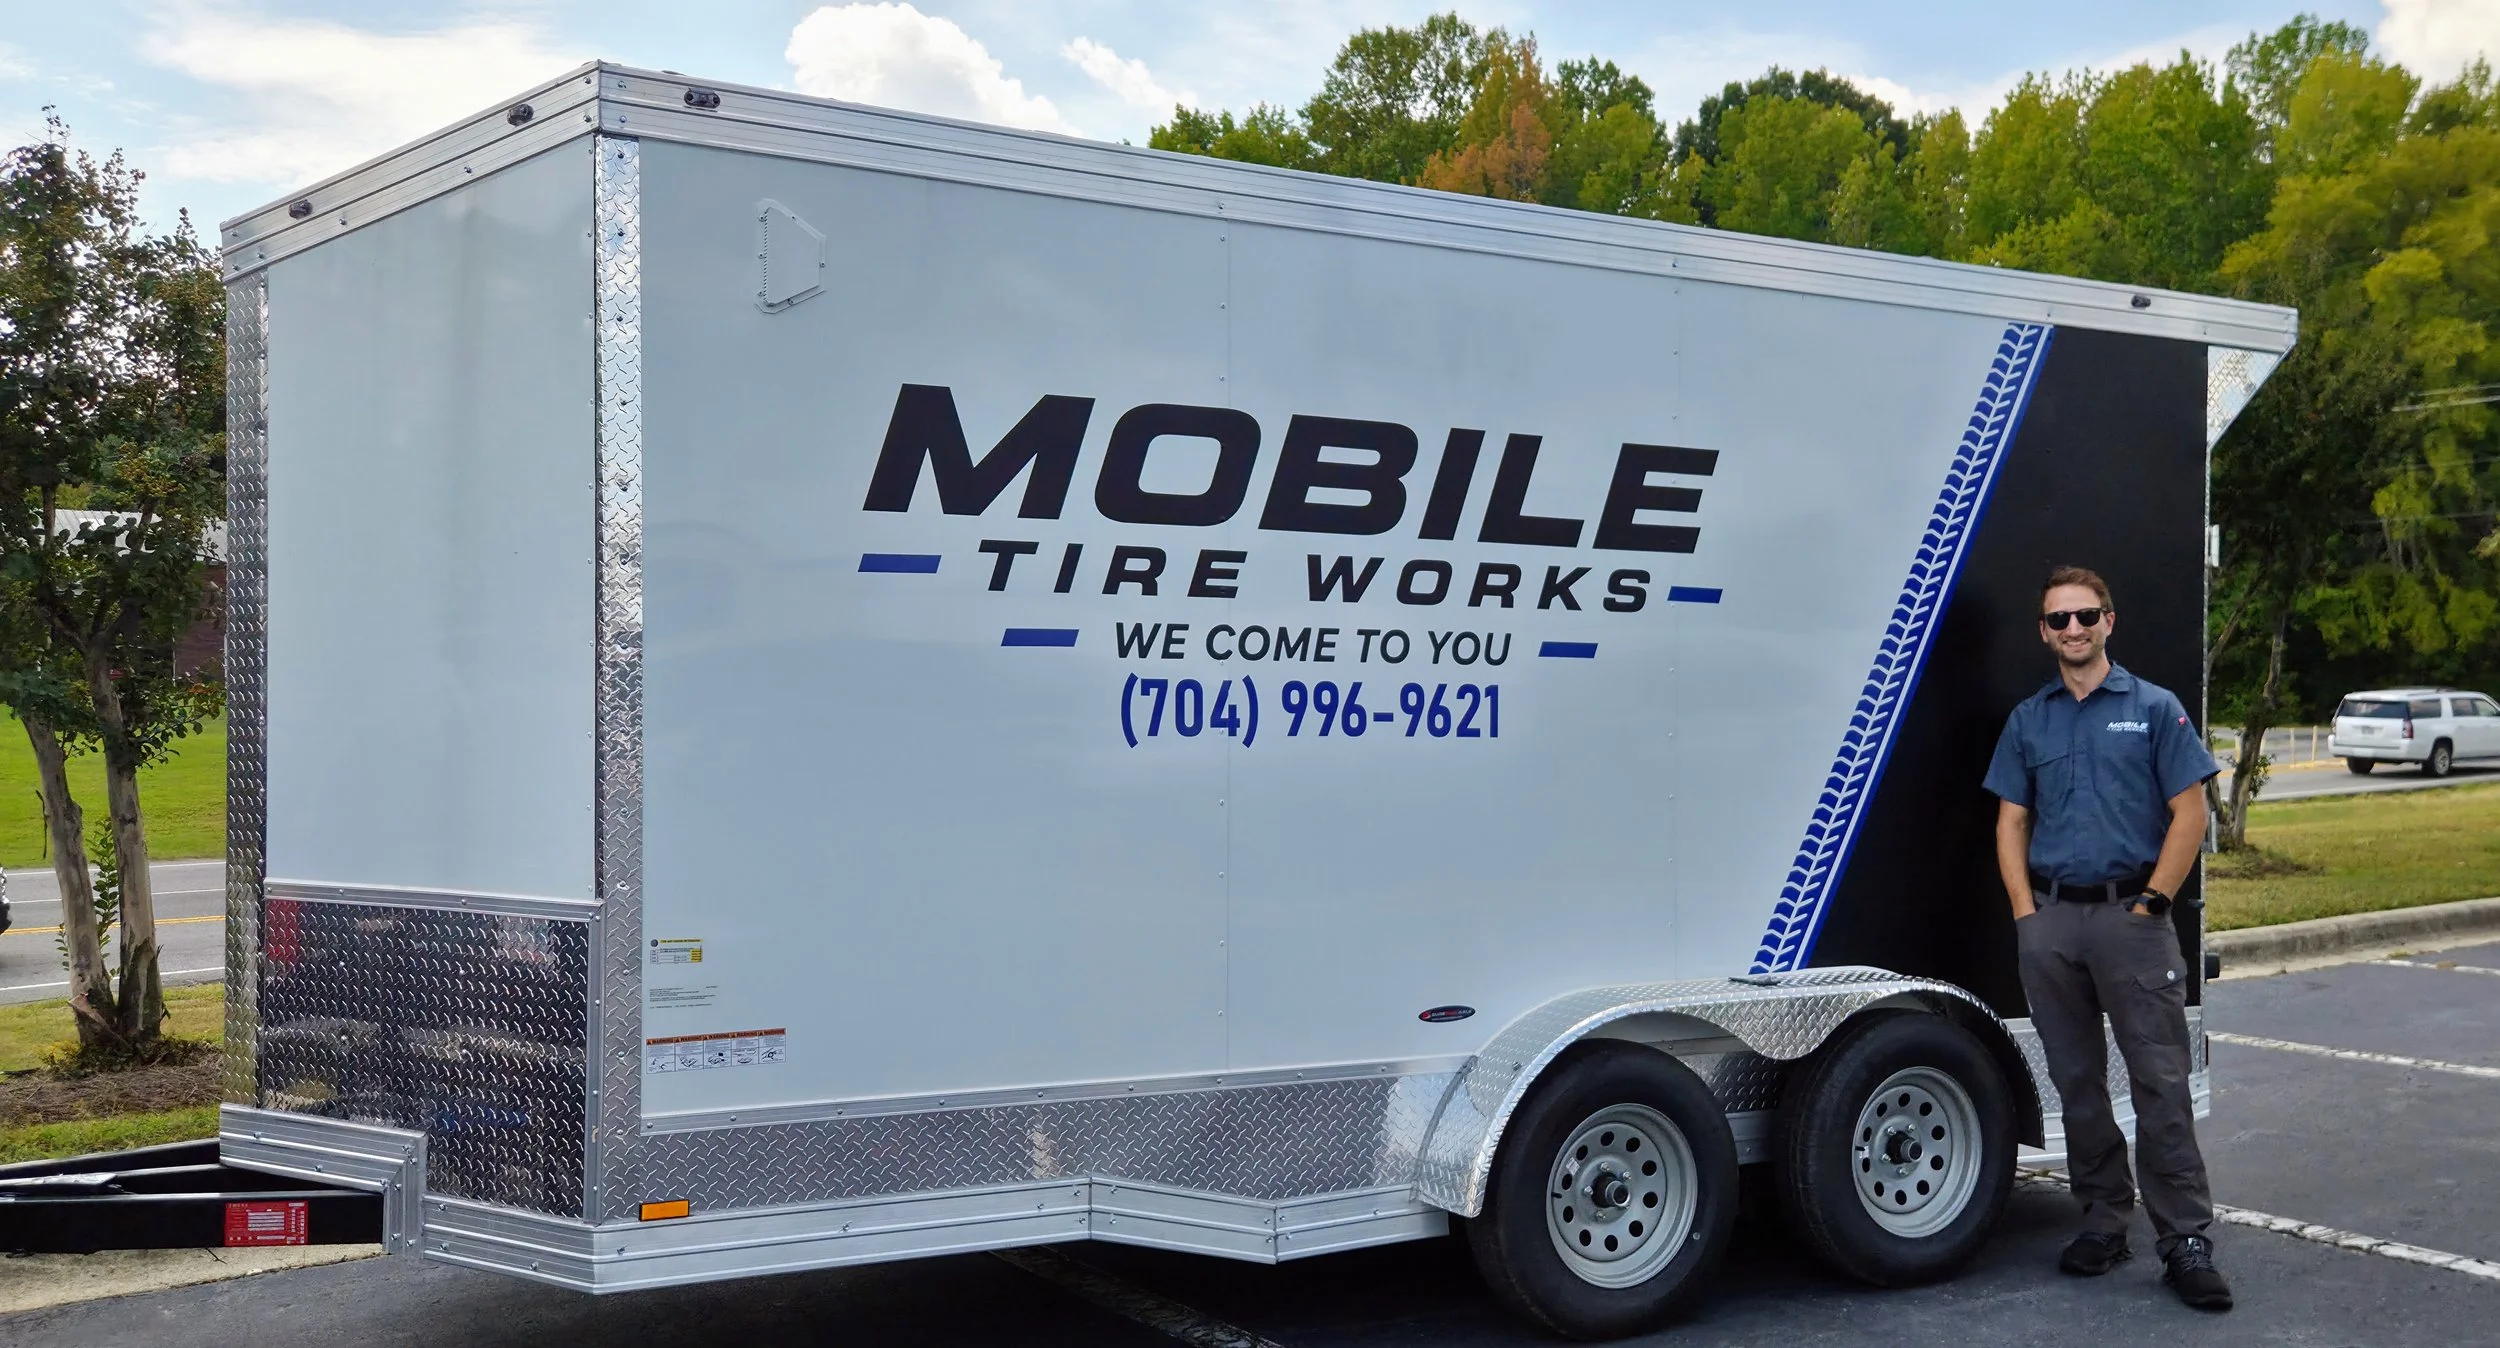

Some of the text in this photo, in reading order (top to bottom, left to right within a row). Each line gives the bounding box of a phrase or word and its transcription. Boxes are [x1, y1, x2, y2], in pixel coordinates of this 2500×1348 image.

[863, 383, 1719, 554] MOBILE
[978, 540, 1650, 613] TIRE WORKS
[1115, 622, 1512, 667] WE COME TO YOU
[1120, 673, 1500, 749] (704) 996-9621
[2108, 721, 2148, 729] MOBILE
